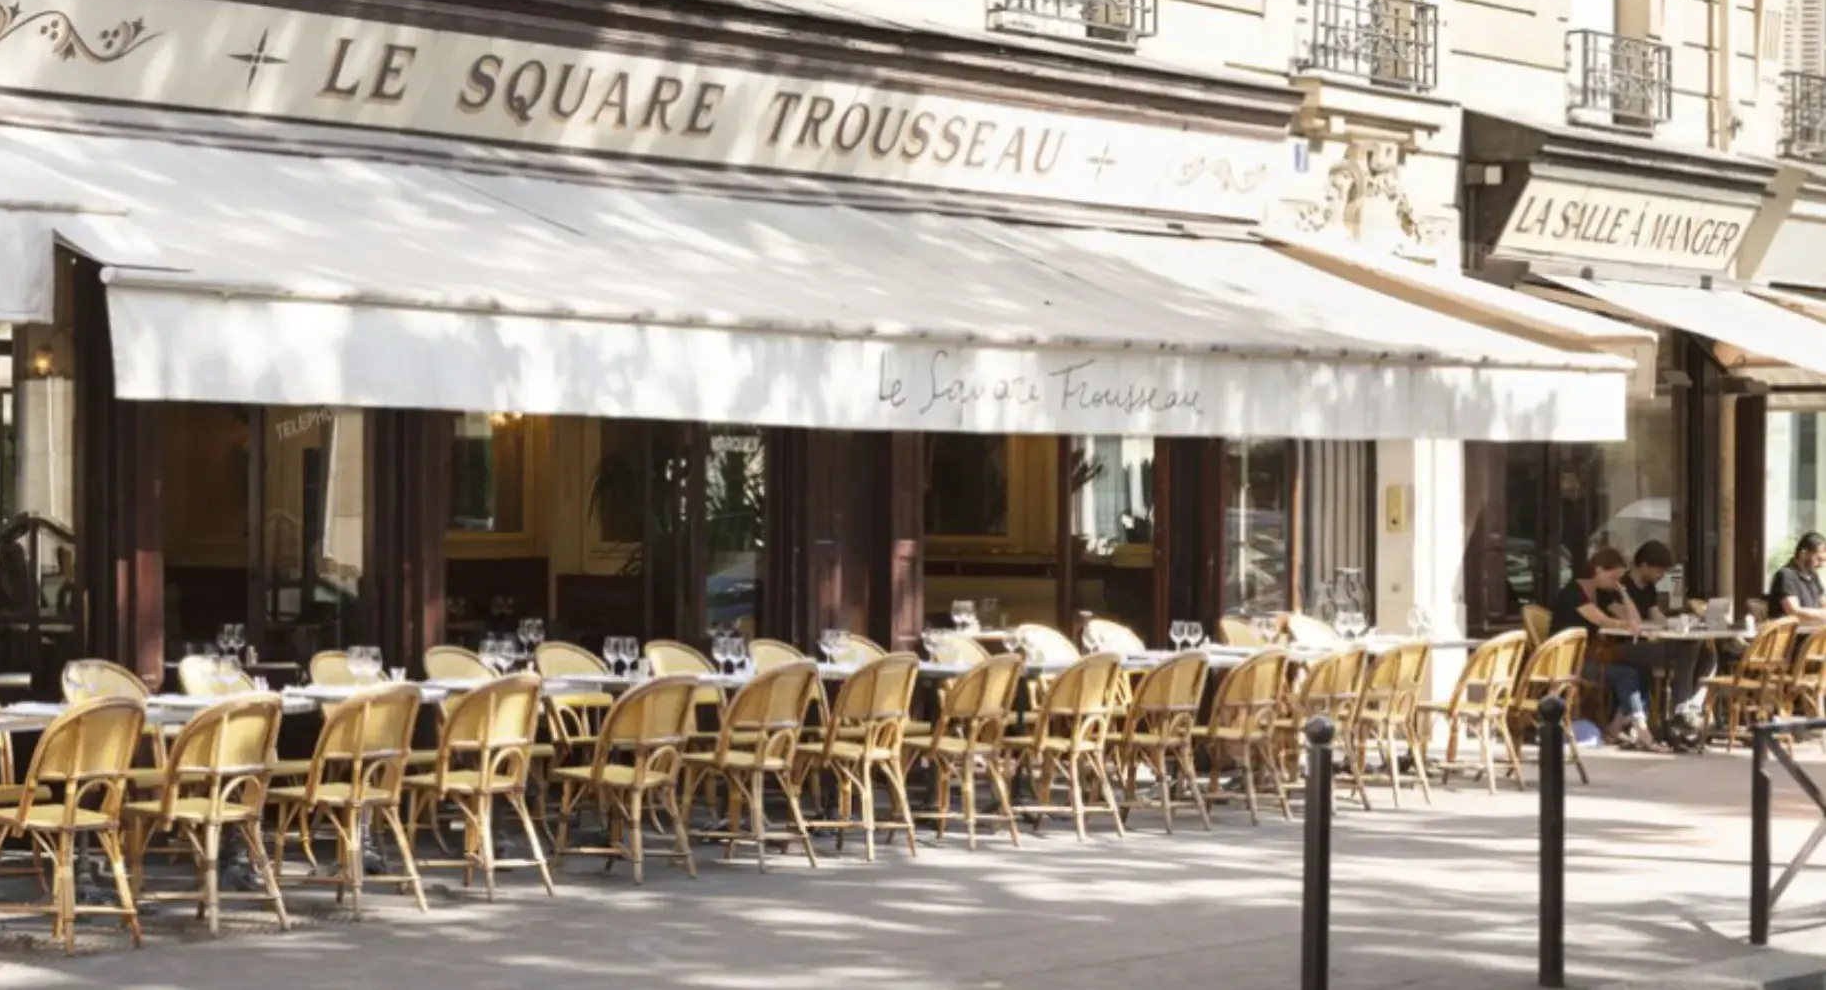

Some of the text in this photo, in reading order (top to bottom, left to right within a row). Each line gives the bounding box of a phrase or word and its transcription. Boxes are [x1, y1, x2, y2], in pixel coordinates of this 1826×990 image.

[316, 37, 1066, 176] LE SQUARE TROUSSEAU
[1515, 195, 1554, 236] LA
[1552, 200, 1630, 245] SALLE
[1649, 212, 1741, 257] MANGER
[919, 350, 1041, 428] Square
[1050, 358, 1205, 415] Trousseau
